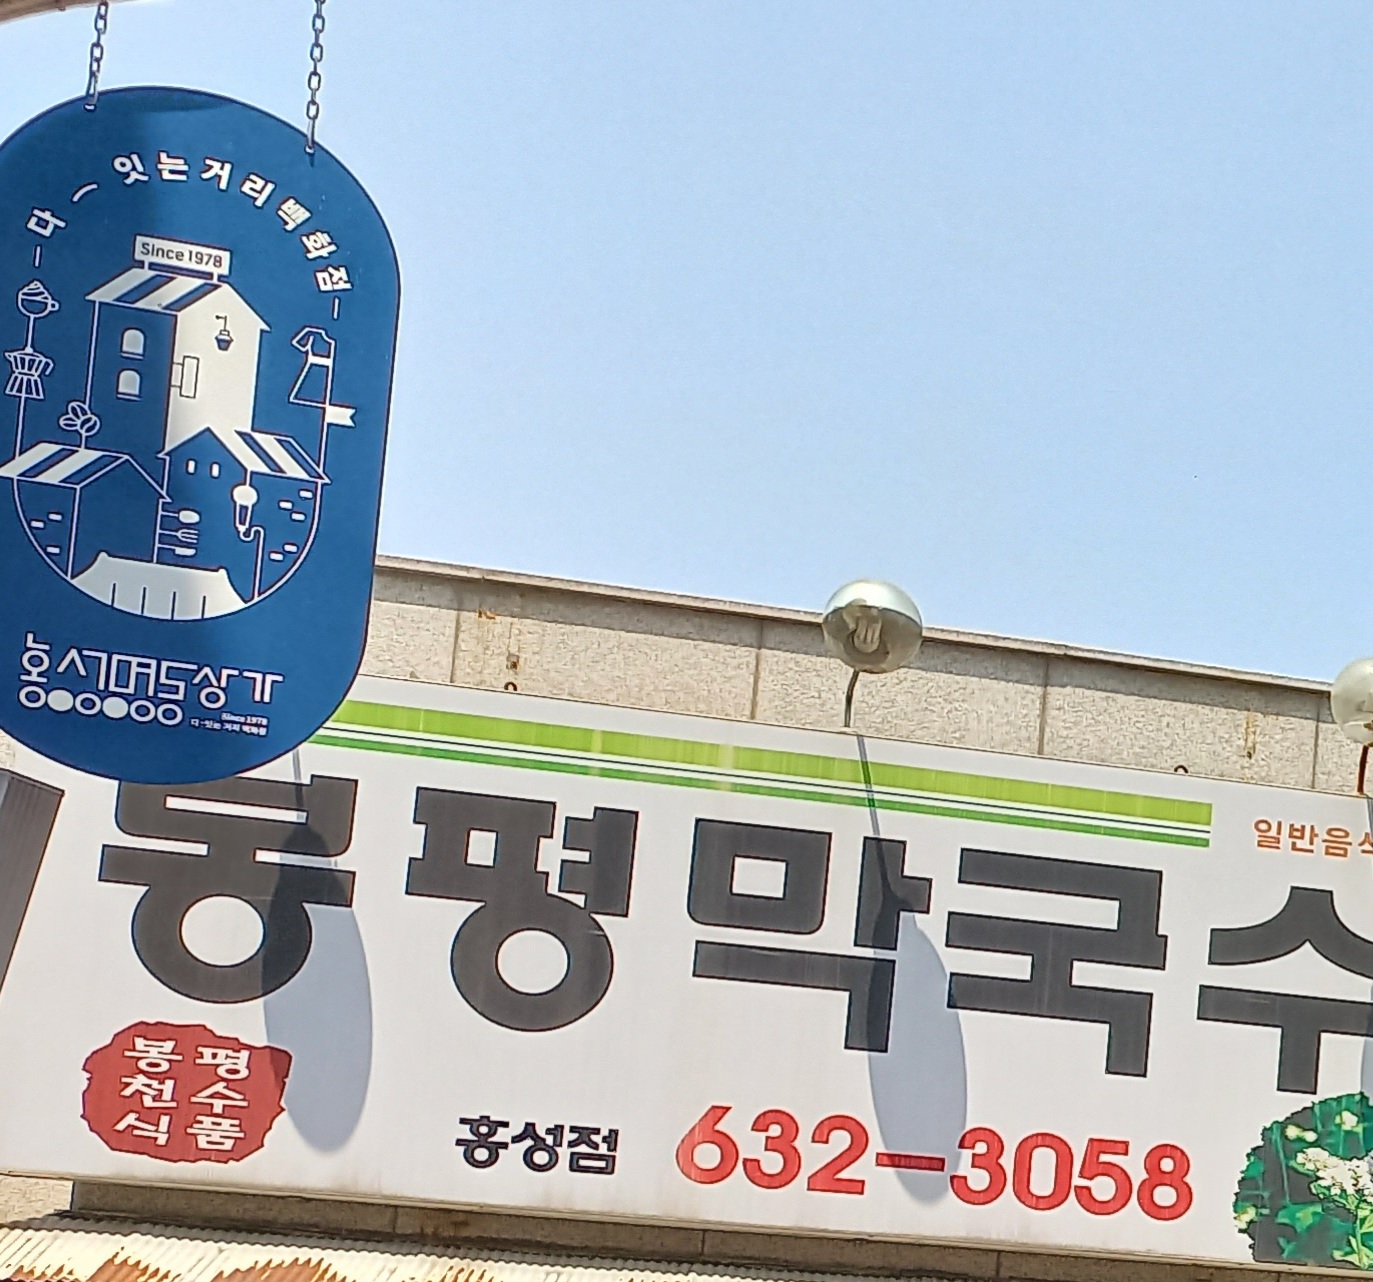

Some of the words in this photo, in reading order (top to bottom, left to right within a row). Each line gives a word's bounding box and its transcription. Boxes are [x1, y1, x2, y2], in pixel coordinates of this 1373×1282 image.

[140, 242, 185, 261] Since
[187, 248, 223, 269] 1978
[455, 1114, 621, 1176] 홍성점
[675, 1104, 1194, 1223] 632-3058
